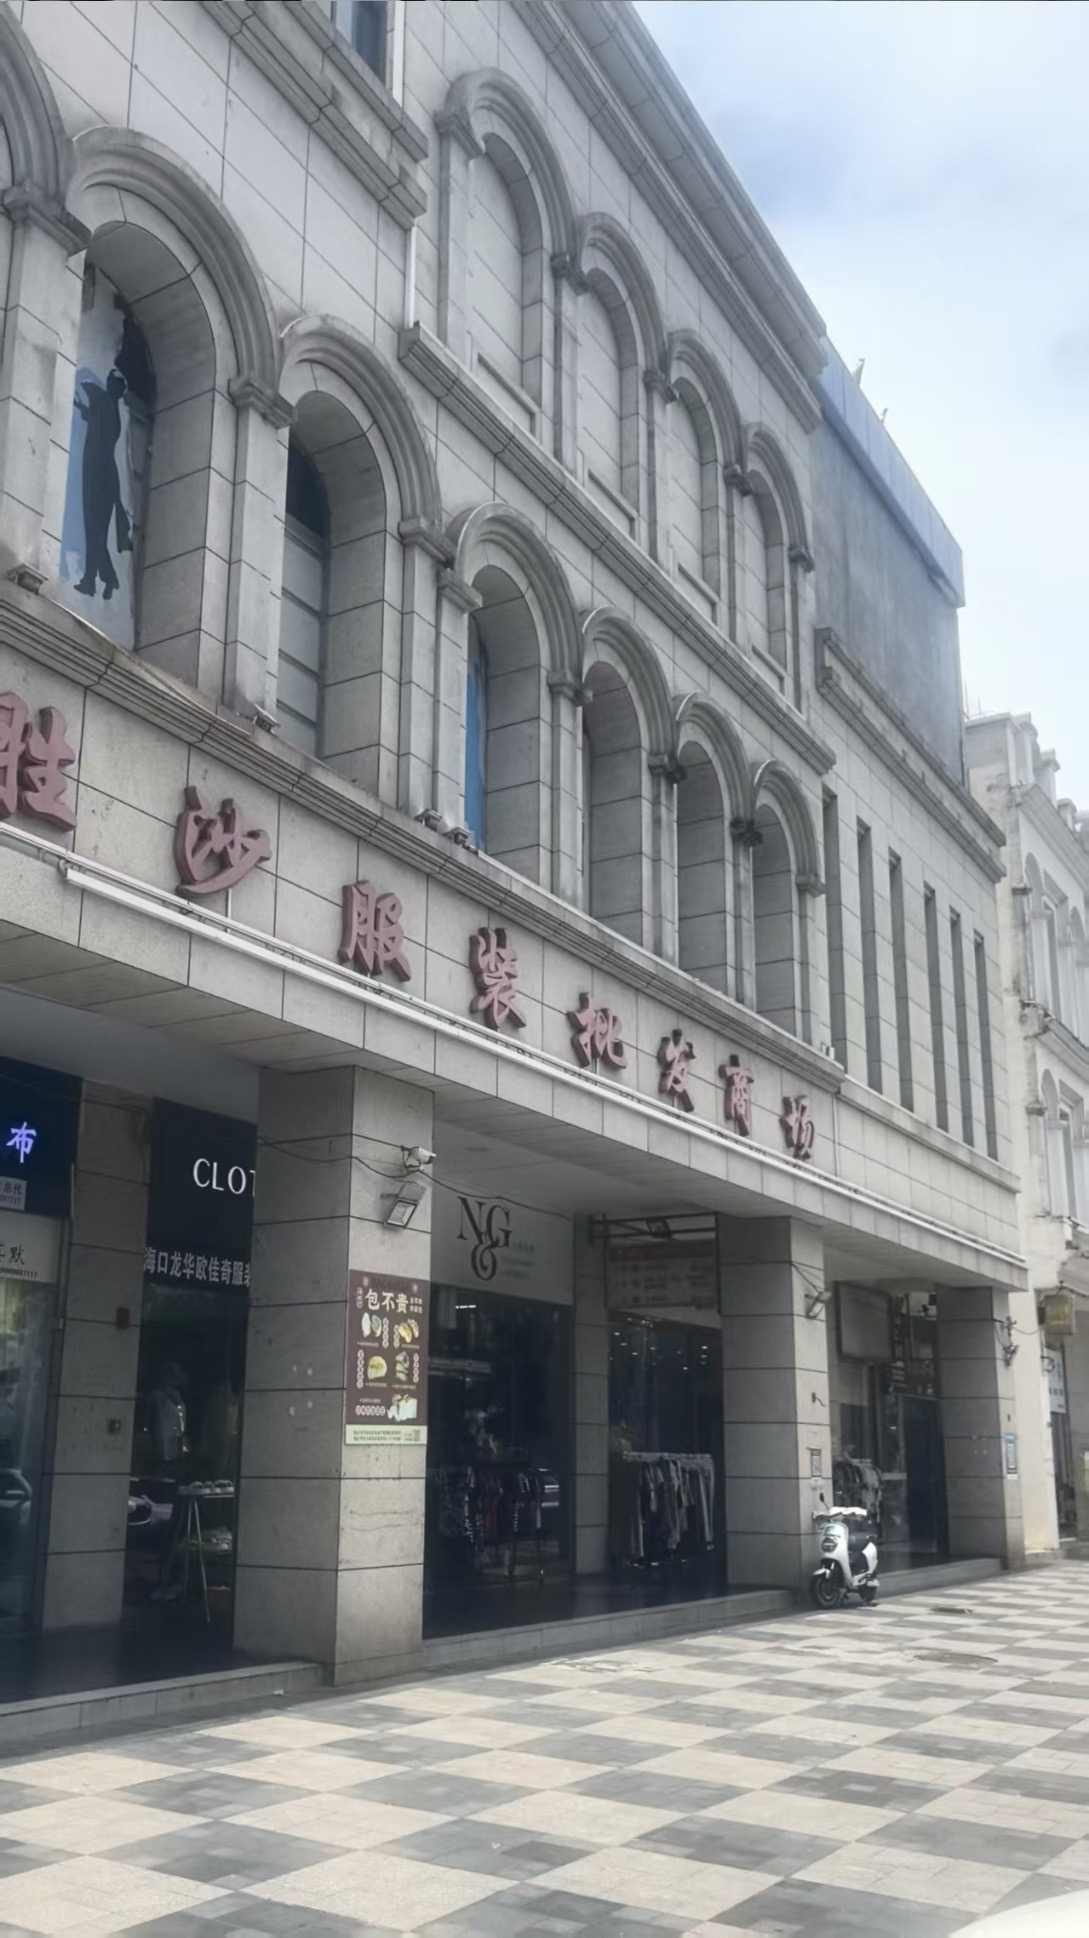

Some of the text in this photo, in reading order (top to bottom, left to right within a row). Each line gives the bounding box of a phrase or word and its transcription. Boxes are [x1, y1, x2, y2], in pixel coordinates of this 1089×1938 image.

[6, 1121, 37, 1164] 布
[364, 1288, 409, 1314] 包不贵
